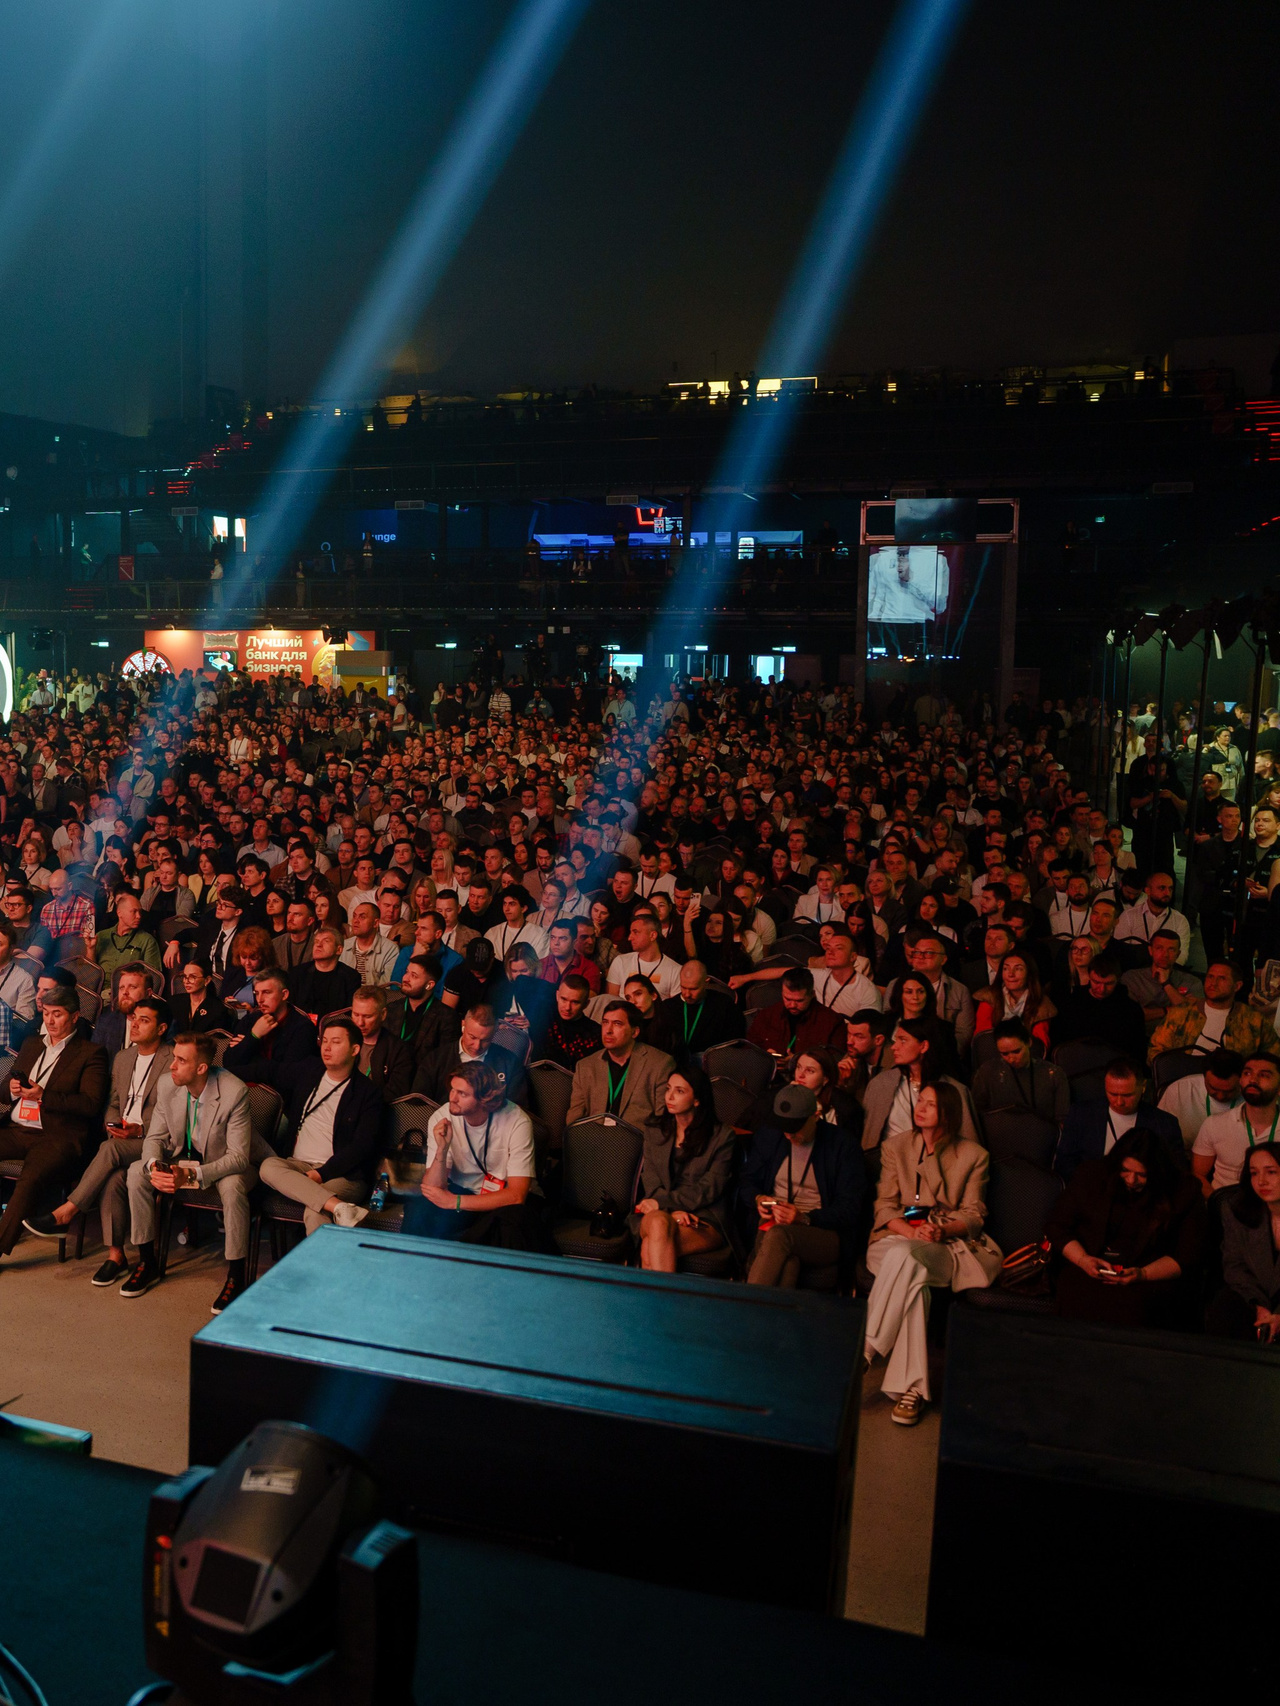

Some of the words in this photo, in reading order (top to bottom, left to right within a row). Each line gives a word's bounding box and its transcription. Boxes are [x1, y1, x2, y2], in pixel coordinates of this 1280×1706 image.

[246, 636, 303, 649] Лучший
[246, 648, 279, 660] банк
[281, 651, 307, 662] для
[246, 661, 303, 673] бизнеса
